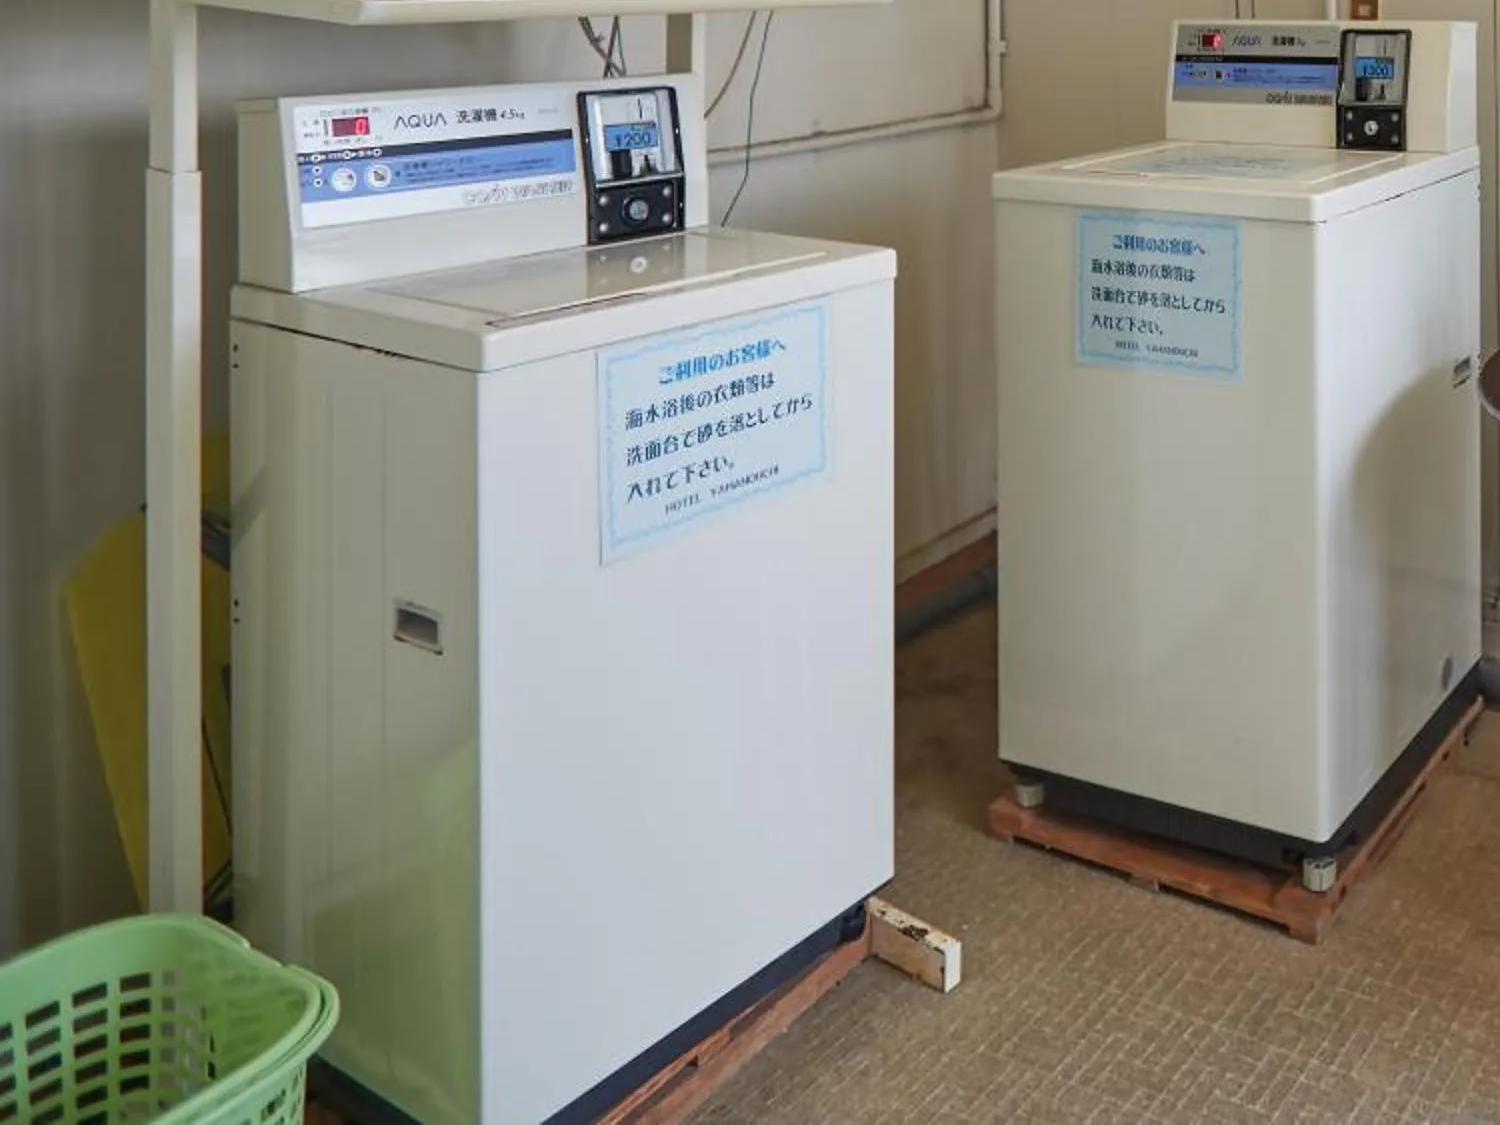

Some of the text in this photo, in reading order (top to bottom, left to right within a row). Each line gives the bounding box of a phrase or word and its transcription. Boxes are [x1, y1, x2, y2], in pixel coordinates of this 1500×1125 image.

[1232, 35, 1263, 47] AQUA
[395, 112, 448, 130] AQUA
[456, 108, 497, 124] 洗濯機
[658, 338, 787, 386] ご利用のお客様へ
[624, 371, 776, 431] 海水浴後の衣類等は
[626, 393, 813, 467] 洗面台で砂を落としてから
[627, 455, 735, 503] 入れて下さい。
